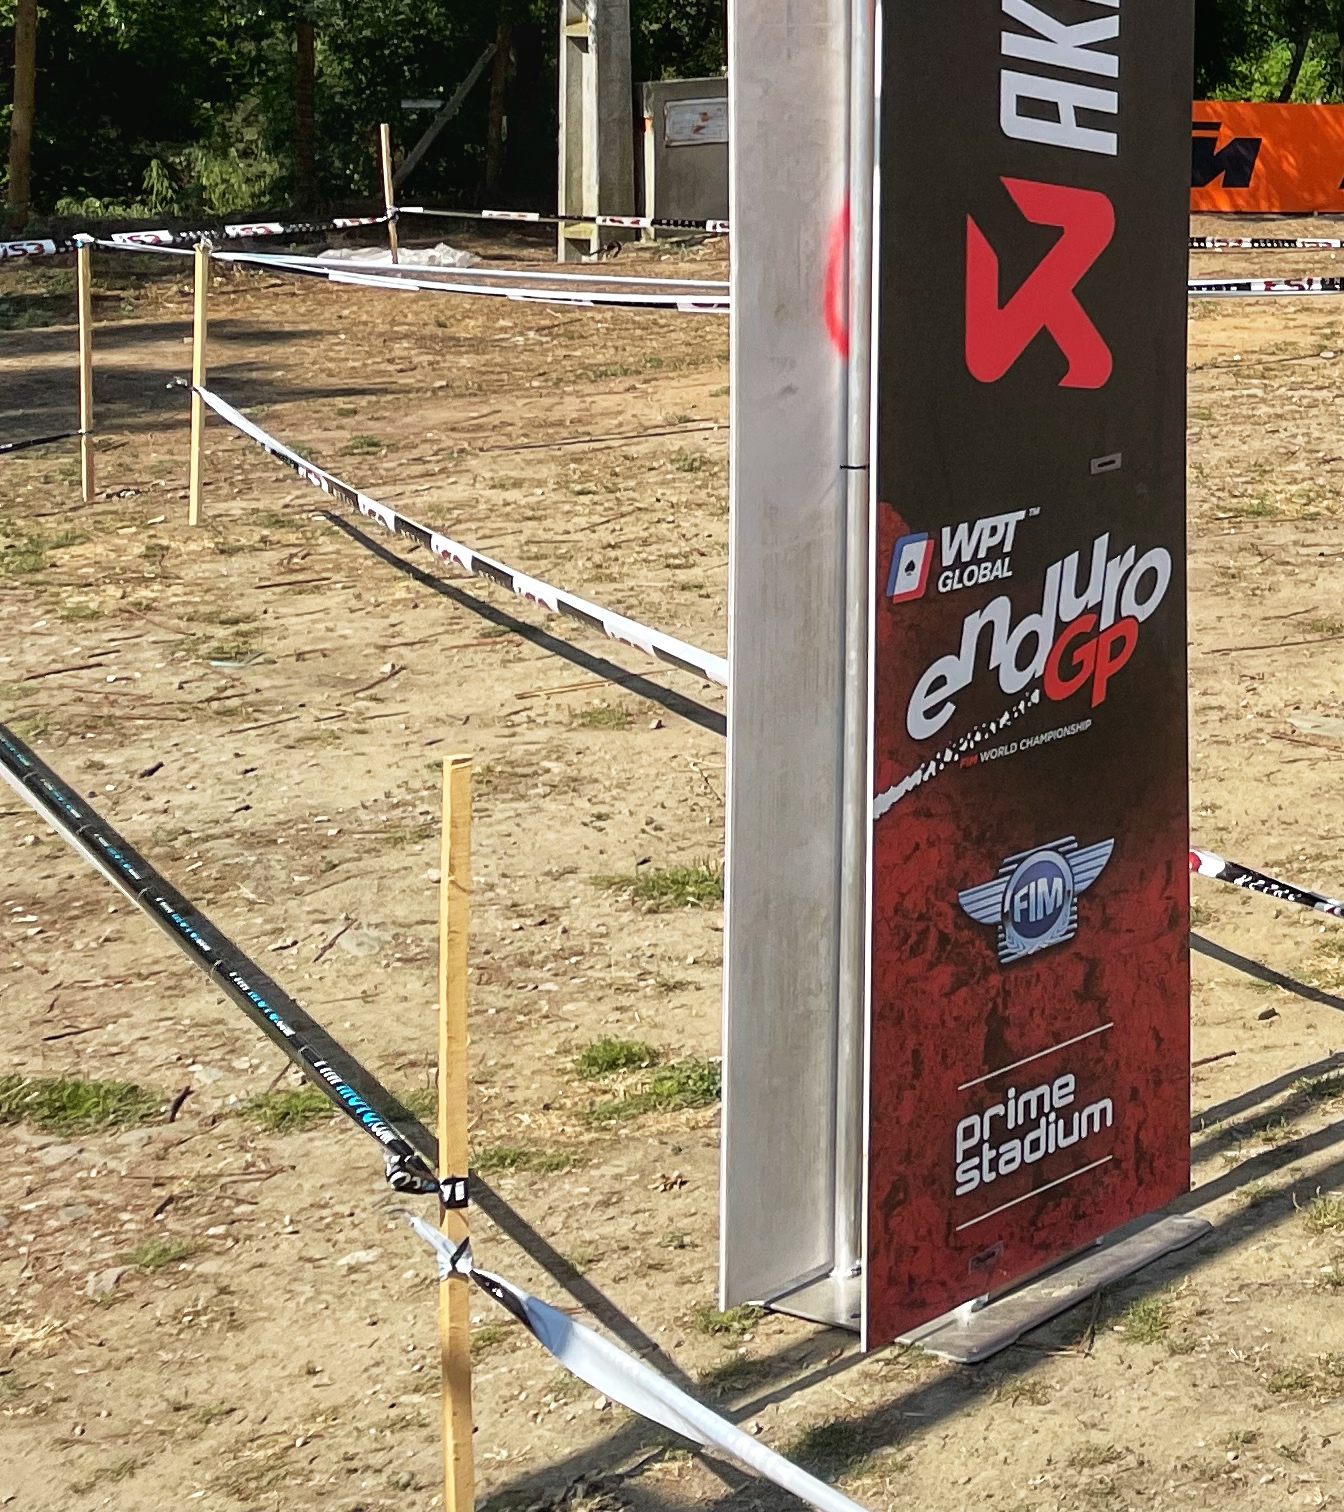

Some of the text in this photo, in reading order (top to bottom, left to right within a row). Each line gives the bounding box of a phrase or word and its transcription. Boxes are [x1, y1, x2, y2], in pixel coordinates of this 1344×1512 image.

[937, 556, 1013, 593] GLOBAL
[941, 510, 1026, 567] WPT
[906, 531, 1173, 740] enduro
[1043, 612, 1140, 709] GP
[959, 718, 1093, 769] FIM WORLD CHAMPIONSHIP
[1013, 876, 1064, 924] FIM
[955, 1096, 1113, 1197] stadium
[956, 1073, 1076, 1164] prime
